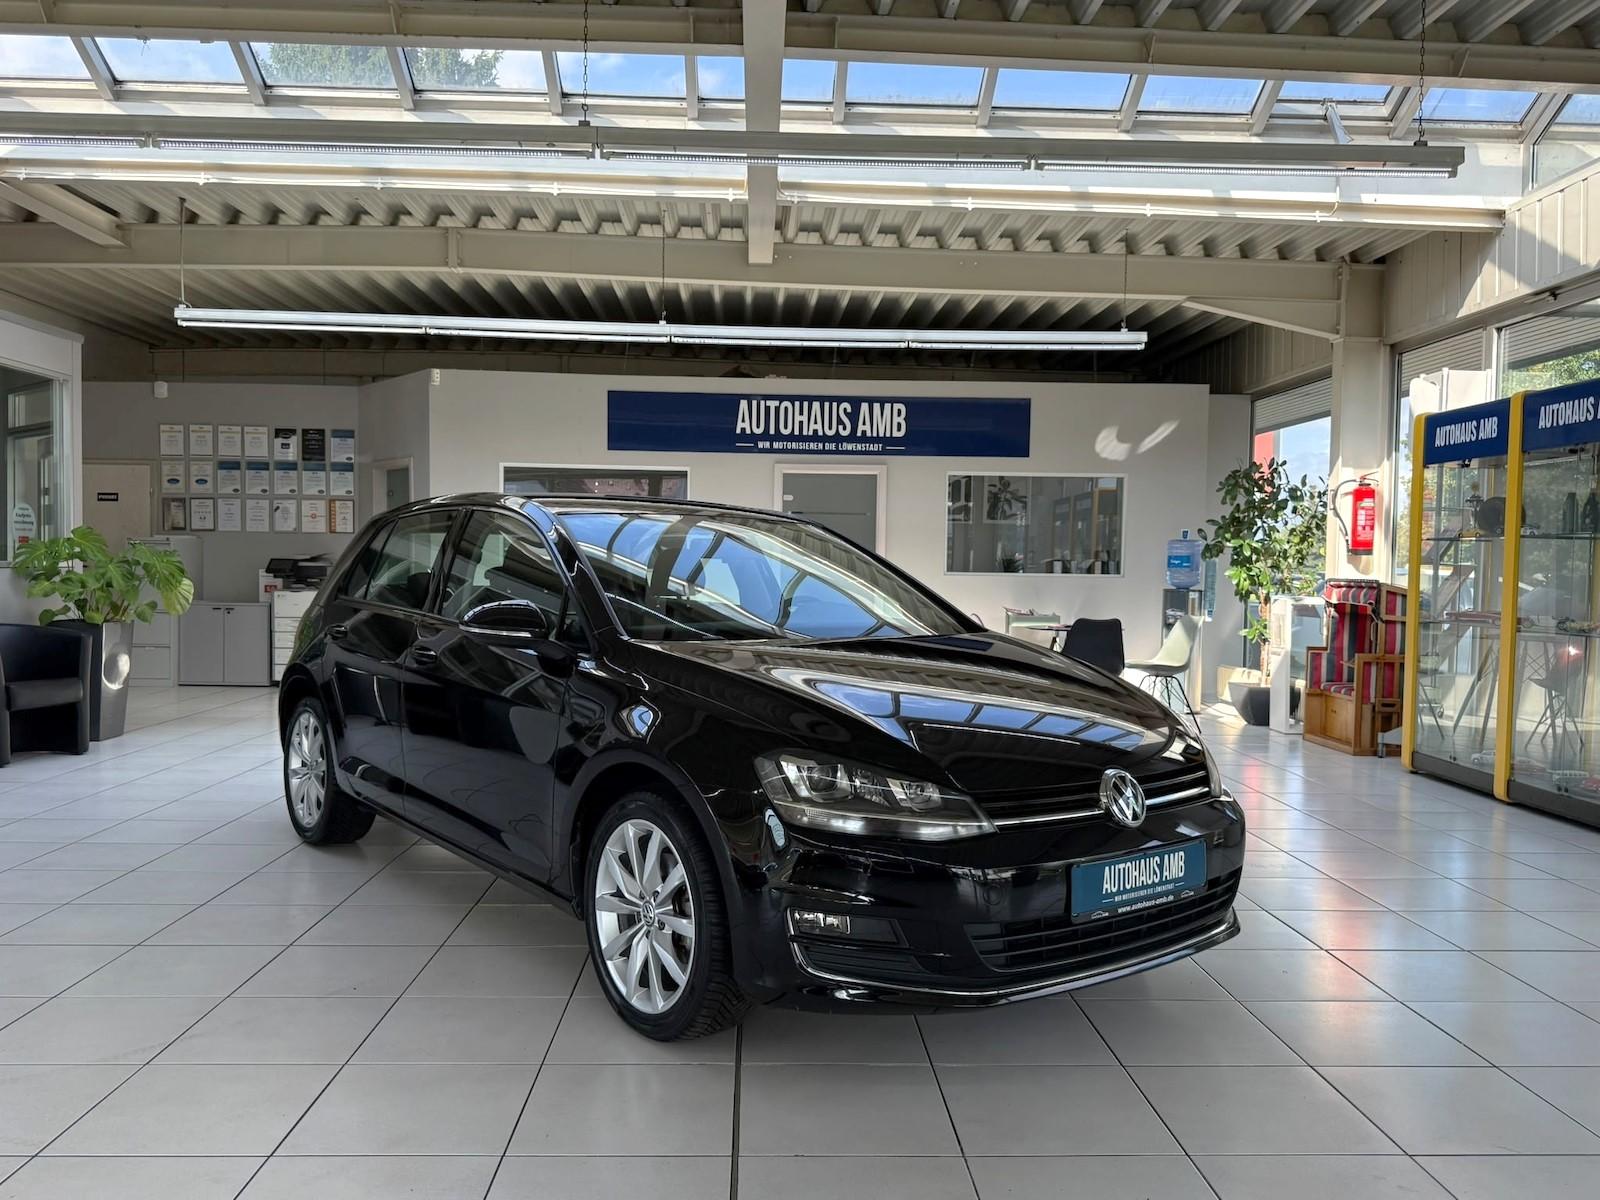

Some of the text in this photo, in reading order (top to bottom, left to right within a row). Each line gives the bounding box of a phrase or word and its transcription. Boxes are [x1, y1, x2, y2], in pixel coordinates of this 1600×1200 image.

[736, 399, 907, 438] AUTOHAUS AMB
[1538, 396, 1594, 429] AUTOHAUS
[757, 440, 883, 451] WIR MOTORISIEREN DIE LÖWENSTADT
[1435, 416, 1498, 447] AUTOHAUS AMB
[1102, 851, 1185, 894] AUTOHAUS AMB
[1117, 894, 1175, 913] www.autohaus-amb.de
